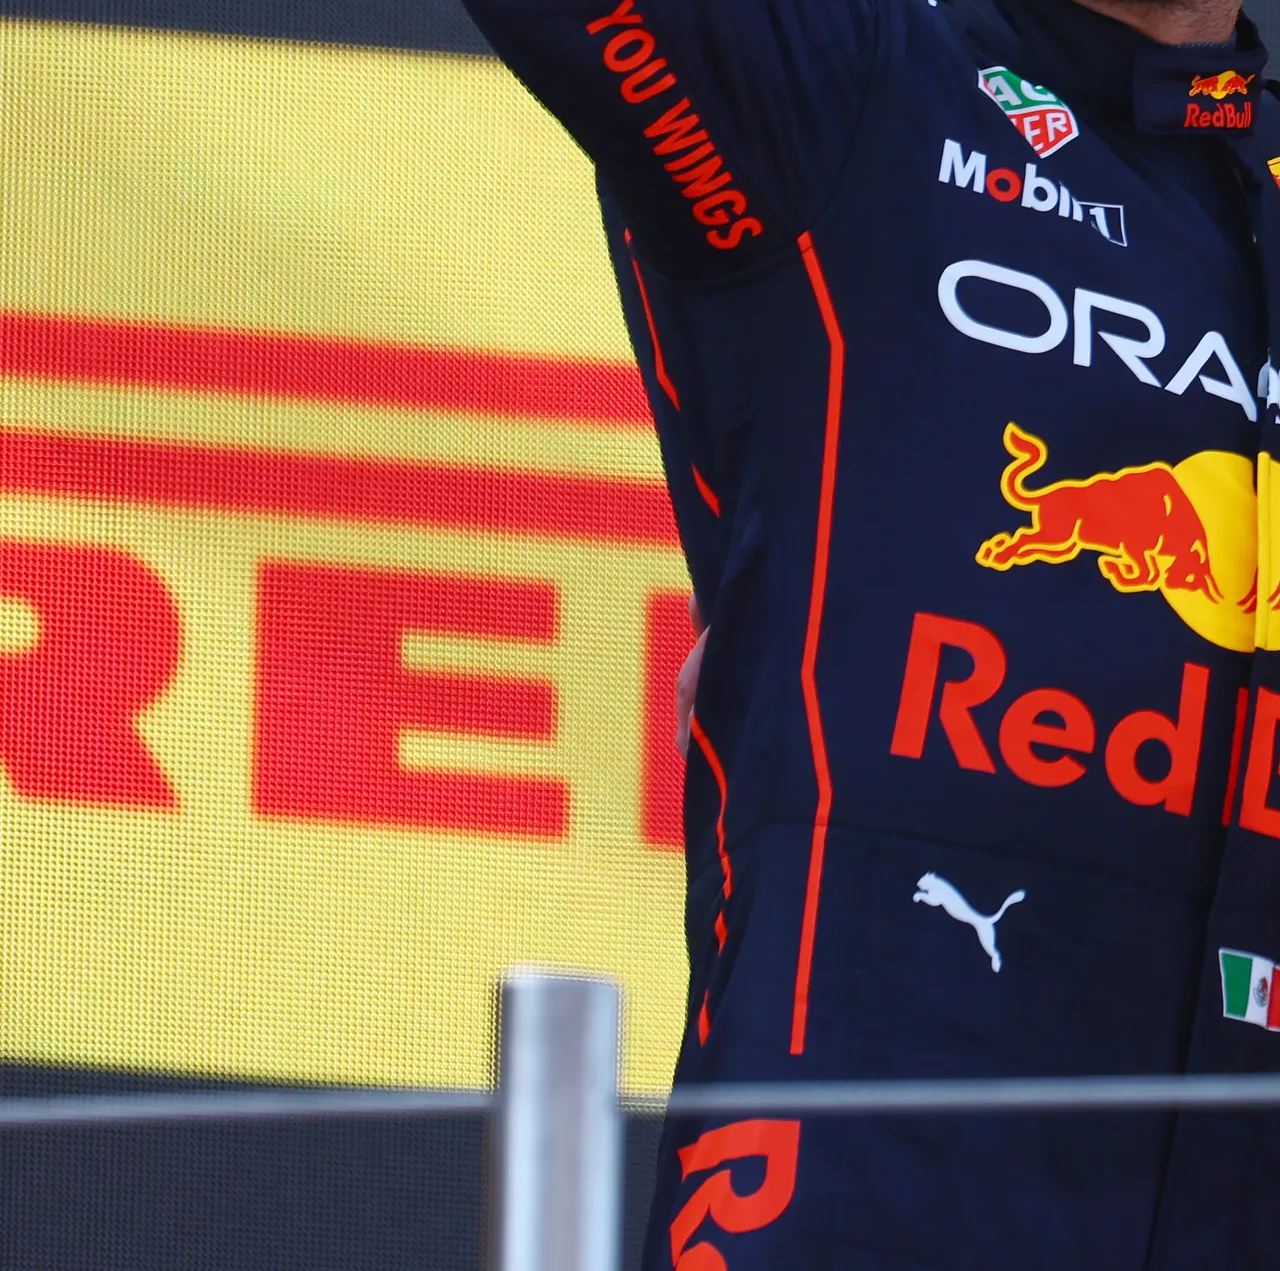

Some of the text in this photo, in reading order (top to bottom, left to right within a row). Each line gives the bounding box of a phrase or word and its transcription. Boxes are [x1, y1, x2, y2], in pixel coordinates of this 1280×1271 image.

[644, 98, 764, 250] WINGS
[1183, 101, 1253, 129] Red Bull
[890, 611, 1211, 816] Red
